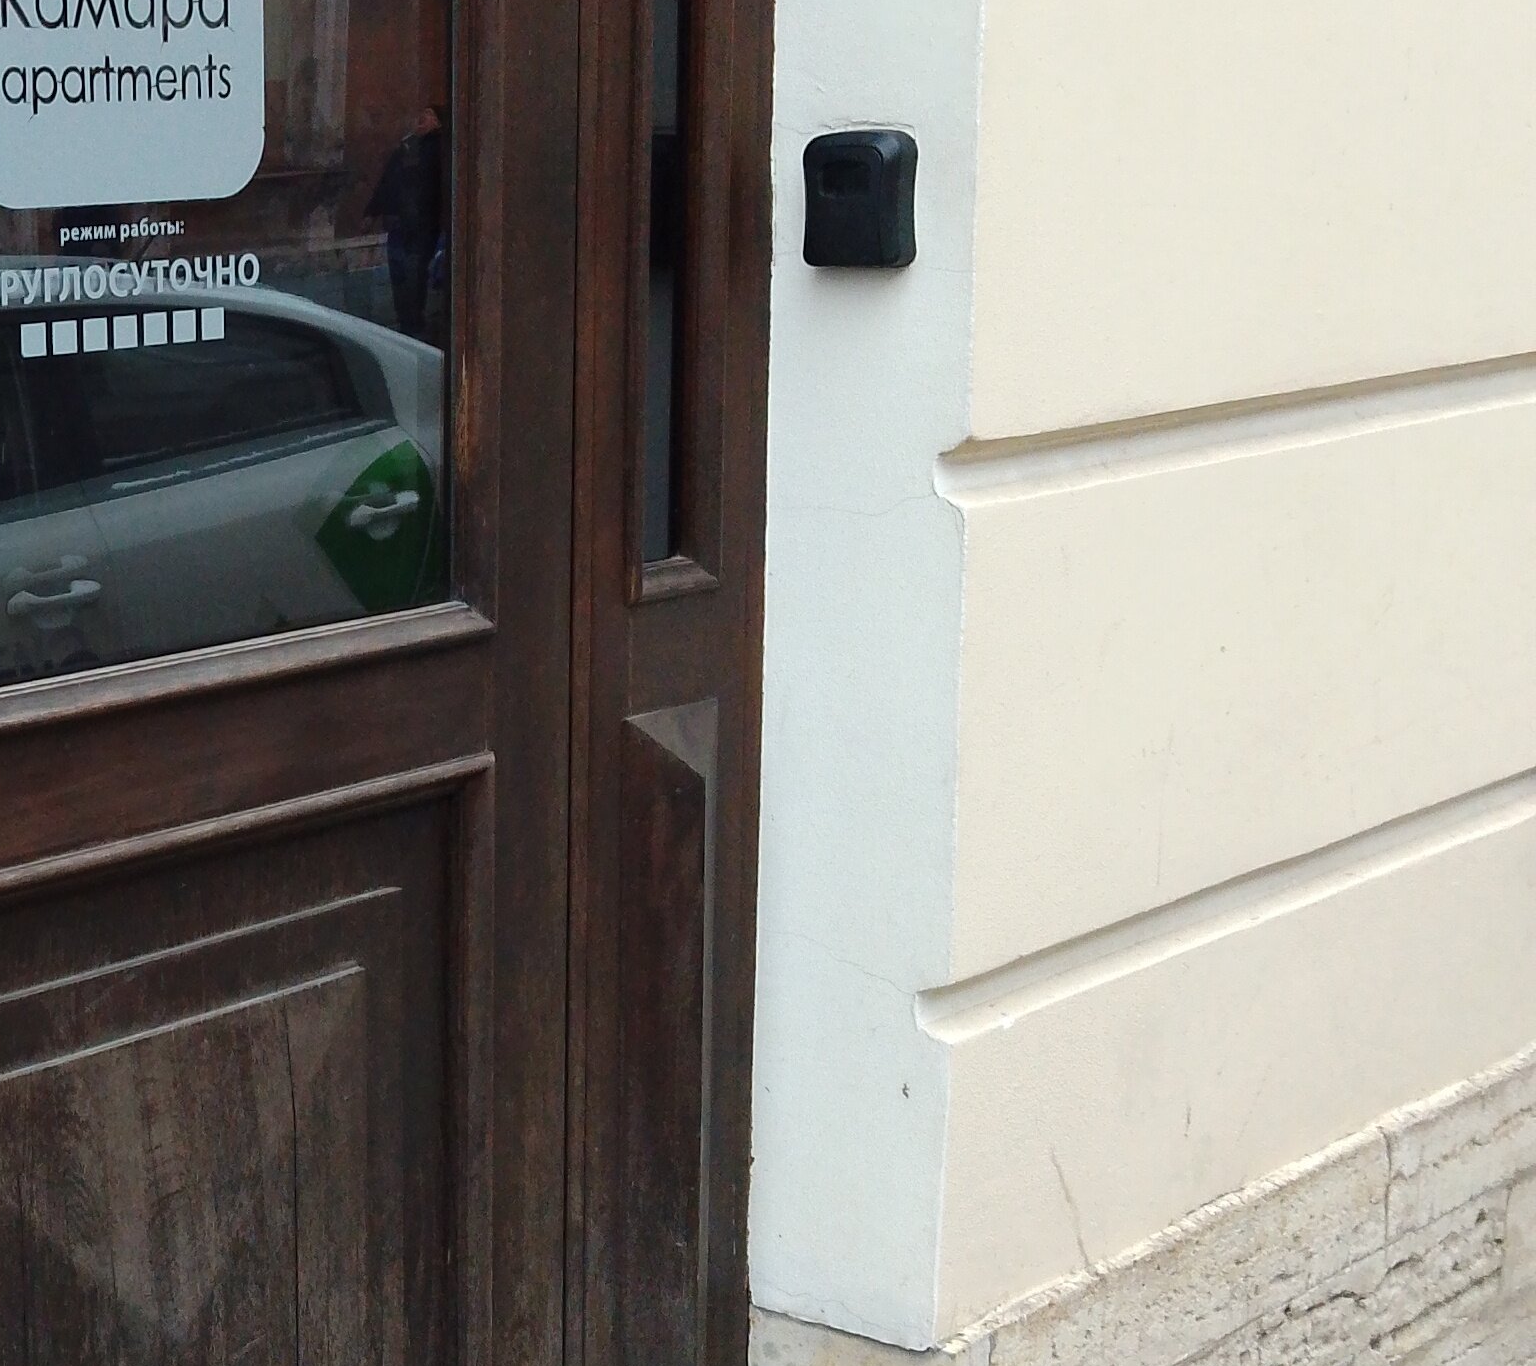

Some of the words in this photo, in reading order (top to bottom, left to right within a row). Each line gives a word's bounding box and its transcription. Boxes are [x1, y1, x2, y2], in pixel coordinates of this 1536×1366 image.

[1, 53, 231, 115] apartments
[60, 224, 116, 246] режим
[120, 217, 185, 242] работы:
